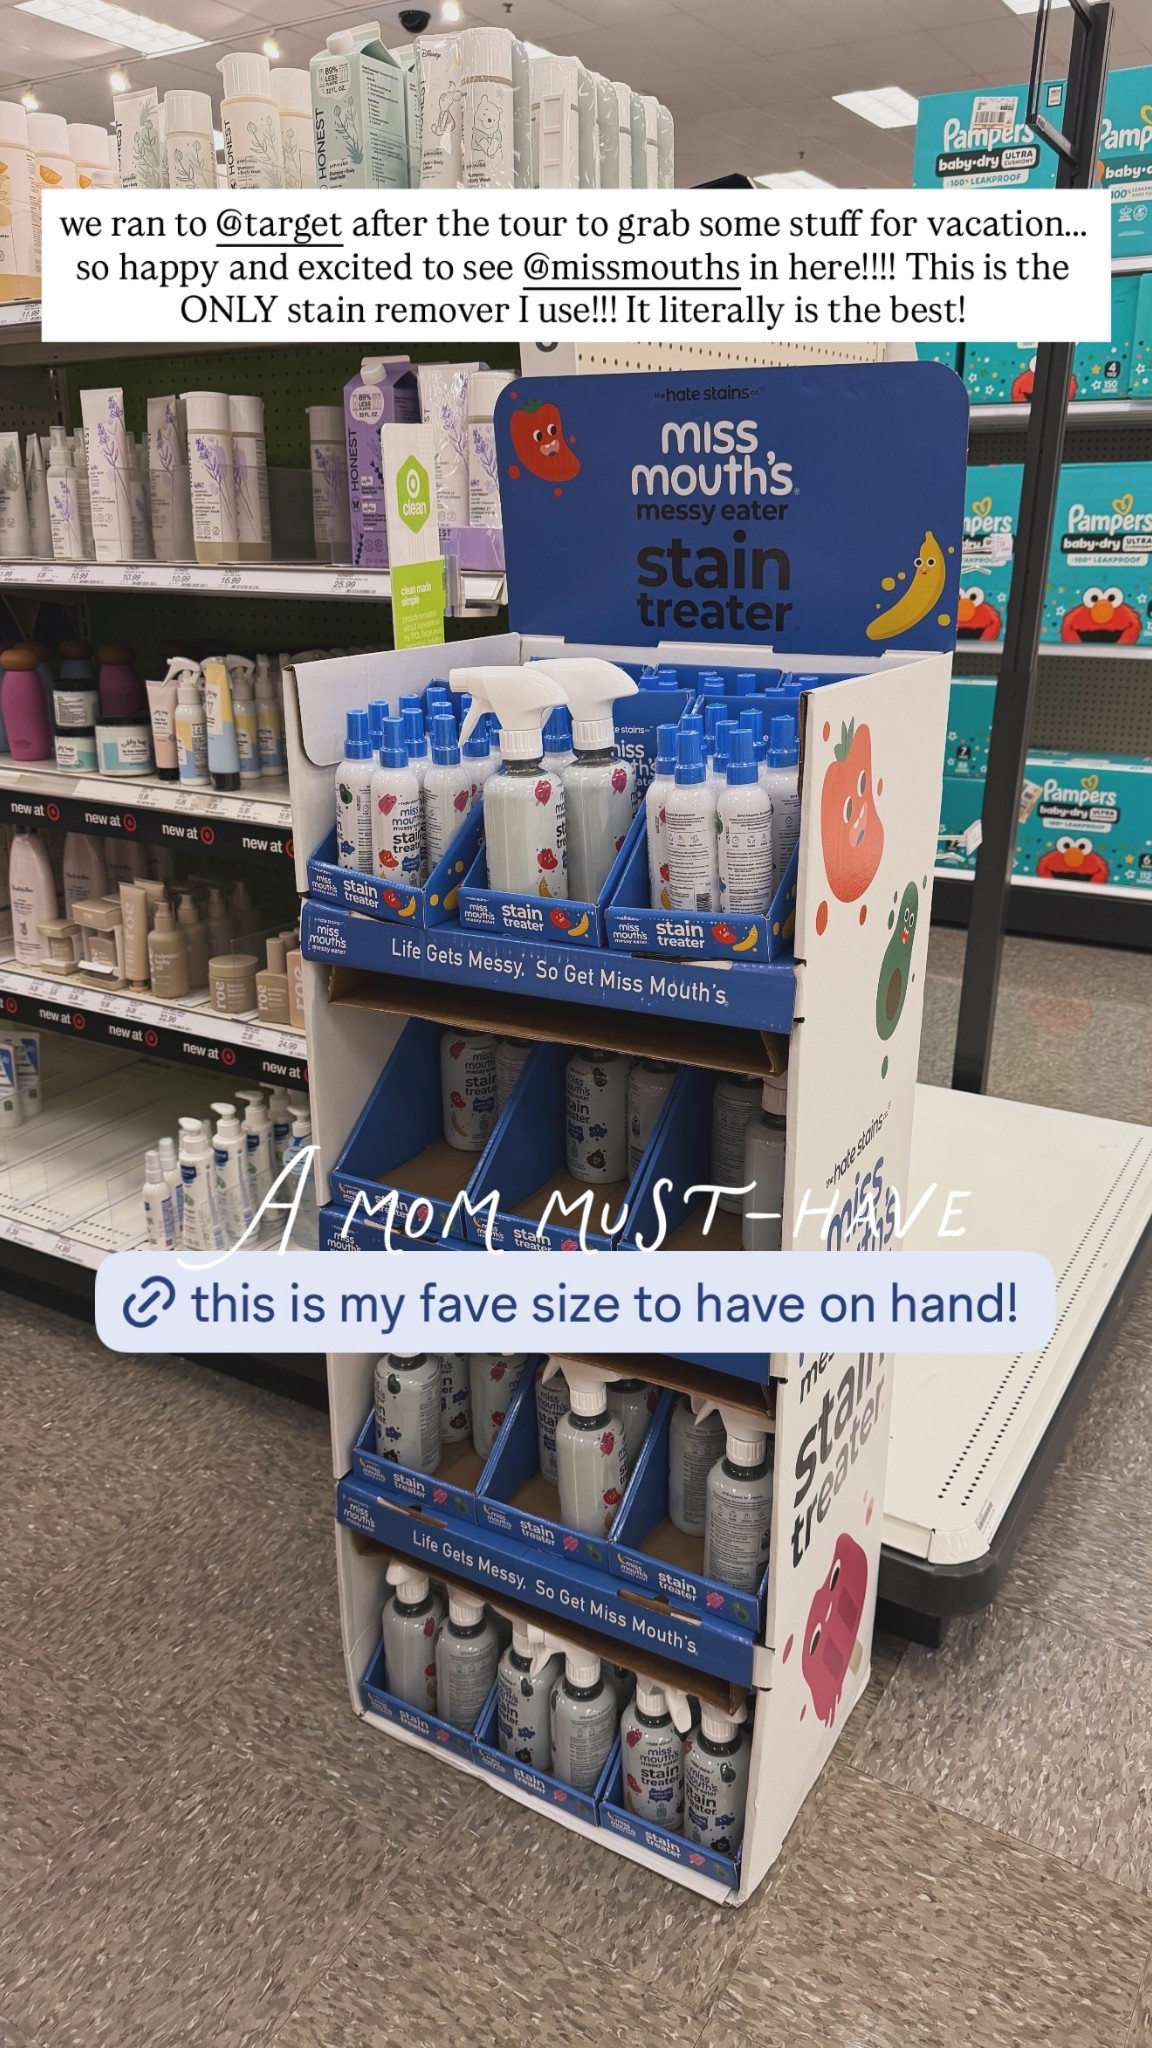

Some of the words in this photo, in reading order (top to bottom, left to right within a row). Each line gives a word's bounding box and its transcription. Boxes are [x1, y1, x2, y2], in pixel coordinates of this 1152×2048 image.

[315, 108, 327, 180] HONEST
[943, 118, 1035, 152] Pampers
[223, 120, 235, 176] HONEST
[1005, 151, 1034, 160] ULTRA
[970, 173, 1022, 186] LEAKPROOF
[358, 393, 372, 401] 89%
[666, 387, 701, 402] hate
[703, 385, 750, 401] stains
[661, 419, 759, 455] miss
[348, 428, 359, 491] HONEST
[631, 450, 794, 497] mouth's
[402, 499, 428, 516] clean
[636, 500, 717, 527] messy
[720, 500, 789, 521] eater
[1067, 503, 1152, 536] Pampers
[636, 529, 791, 590] stain
[1093, 555, 1141, 564] LEAKPROOF
[332, 580, 356, 589] 25.99
[400, 585, 416, 596] clean
[416, 582, 432, 593] made
[401, 595, 420, 607] simple
[636, 593, 794, 632] treater
[620, 726, 646, 734] stains
[1043, 778, 1118, 808] Pampers
[11, 803, 31, 817] new
[33, 804, 46, 817] at
[85, 810, 107, 826] new
[107, 814, 121, 828] at
[162, 822, 184, 838] new
[185, 826, 199, 841] at
[242, 834, 266, 852] new
[266, 839, 283, 854] at
[343, 879, 378, 899] stain
[344, 891, 379, 909] treater
[501, 903, 543, 921] stain
[316, 924, 340, 937] miss
[502, 916, 545, 932] treater
[619, 922, 640, 932] miss
[655, 919, 704, 938] stain
[309, 934, 347, 949] mouth's
[613, 930, 648, 941] mouth's
[656, 935, 705, 949] treater
[391, 937, 422, 960] Life
[426, 944, 463, 967] Gets
[536, 959, 559, 981] So
[564, 964, 594, 986] Get
[600, 968, 643, 993] Miss
[650, 975, 727, 1006] Mouth's
[215, 980, 227, 1010] roe
[258, 984, 268, 1012] roe
[39, 1008, 60, 1022] new
[60, 1012, 72, 1025] at
[108, 1024, 130, 1038] new
[131, 1028, 144, 1042] at
[183, 1041, 206, 1057] new
[206, 1046, 220, 1060] at
[262, 1059, 287, 1076] new
[287, 1063, 302, 1079] at
[833, 1146, 857, 1186] hate
[856, 1113, 883, 1157] stains
[393, 1473, 425, 1492] stain
[393, 1481, 426, 1499] treater
[343, 1508, 376, 1528] mouth's
[349, 1503, 369, 1518] miss
[520, 1520, 555, 1540] stain
[521, 1527, 556, 1547] treater
[412, 1529, 439, 1553] Life
[442, 1542, 474, 1568] Gets
[535, 1579, 555, 1600] So
[559, 1588, 585, 1613] Get
[590, 1599, 627, 1628] Miss
[632, 1615, 697, 1654] Mouth's
[657, 1571, 697, 1595] stain
[658, 1579, 698, 1602] treater
[399, 1710, 429, 1729] stain
[648, 1746, 672, 1757] miss
[513, 1767, 546, 1790] stain
[640, 1765, 680, 1779] stain
[641, 1774, 681, 1787] treater
[645, 1830, 681, 1854] stain
[646, 1838, 682, 1860] treater
